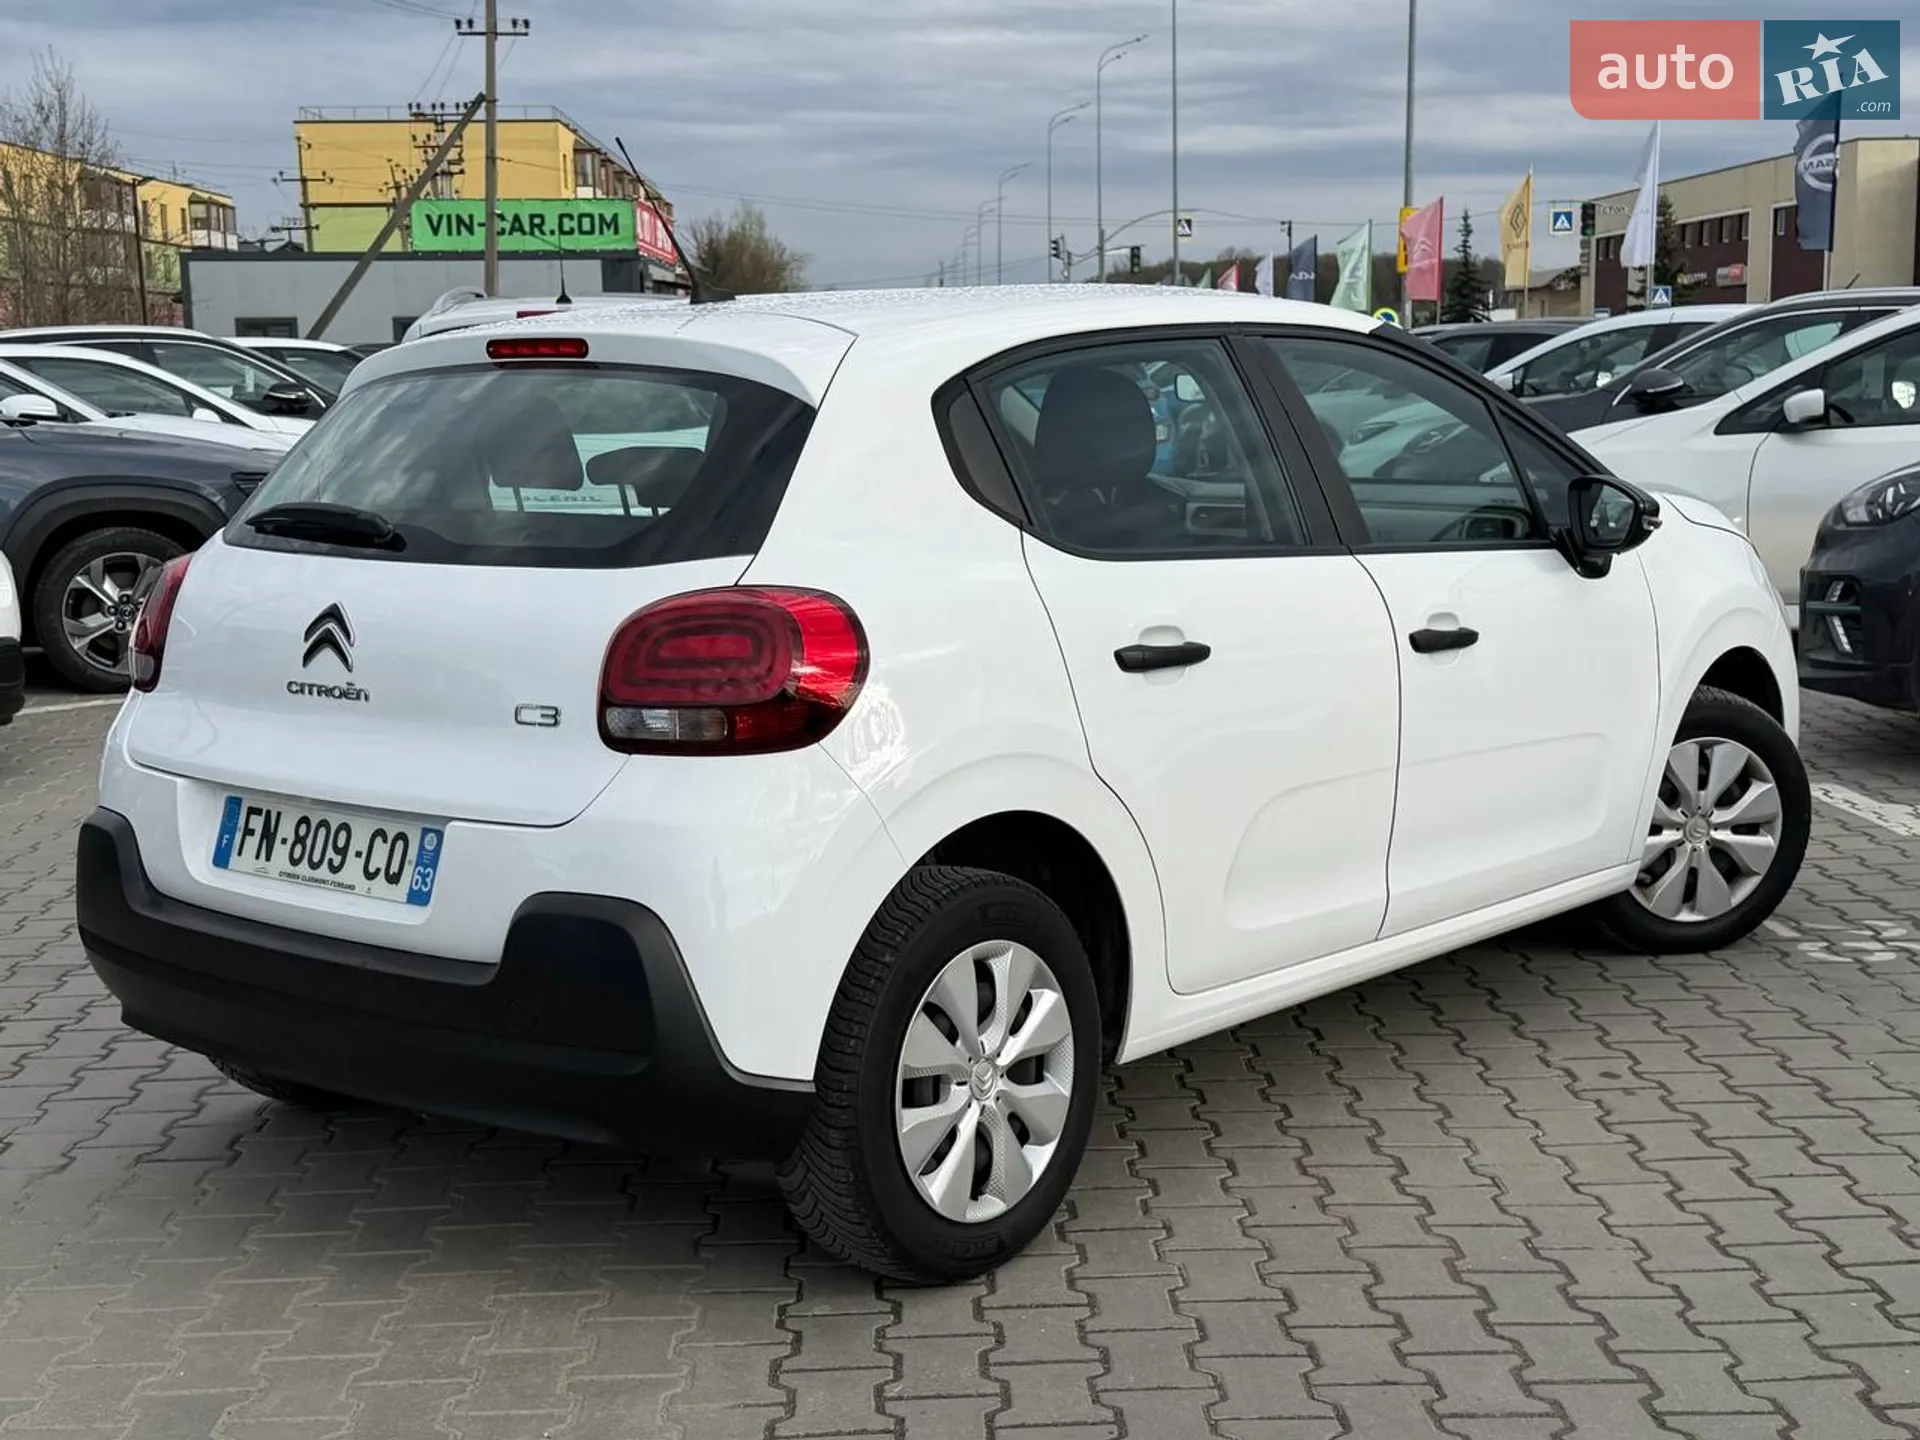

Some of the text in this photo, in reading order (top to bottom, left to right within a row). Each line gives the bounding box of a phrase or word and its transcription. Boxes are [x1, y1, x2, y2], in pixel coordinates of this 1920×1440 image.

[425, 212, 620, 237] VIN-CAR.COM
[514, 703, 561, 728] C3
[237, 806, 410, 888] FN-809-CQ
[412, 865, 434, 892] 63
